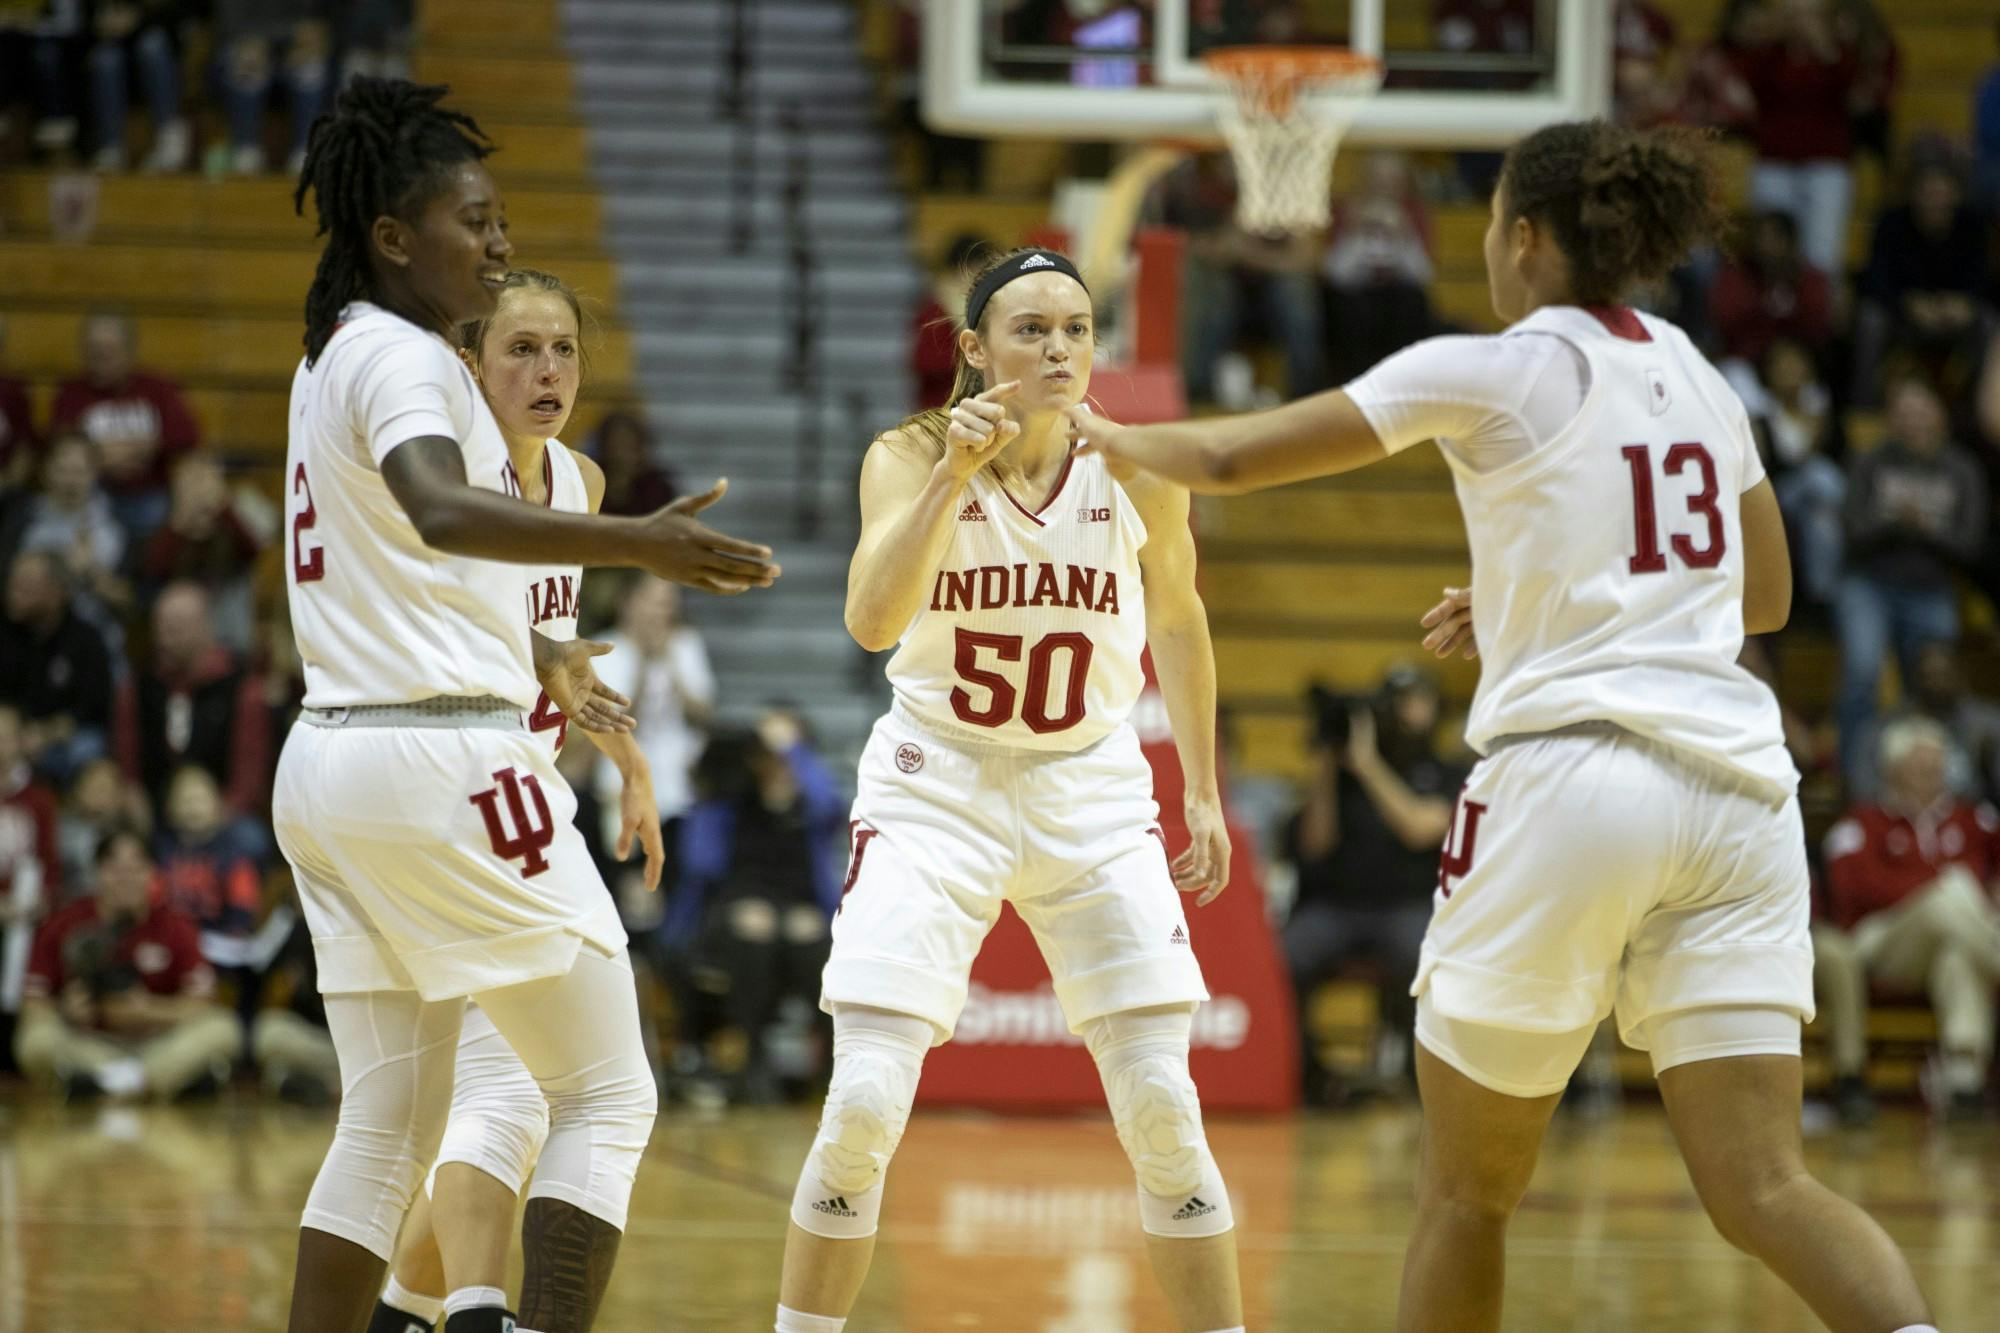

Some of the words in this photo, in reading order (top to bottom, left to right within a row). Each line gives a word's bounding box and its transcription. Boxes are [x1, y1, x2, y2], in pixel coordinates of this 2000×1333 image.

[1020, 260, 1055, 270] adidas
[1621, 442, 1727, 575] 13
[293, 462, 325, 585] 2
[959, 513, 988, 522] adidas
[930, 562, 1120, 615] INDIANA
[949, 626, 1095, 735] 50
[899, 748, 921, 763] 200
[811, 1202, 858, 1218] adidas
[1172, 1205, 1217, 1221] adidas
